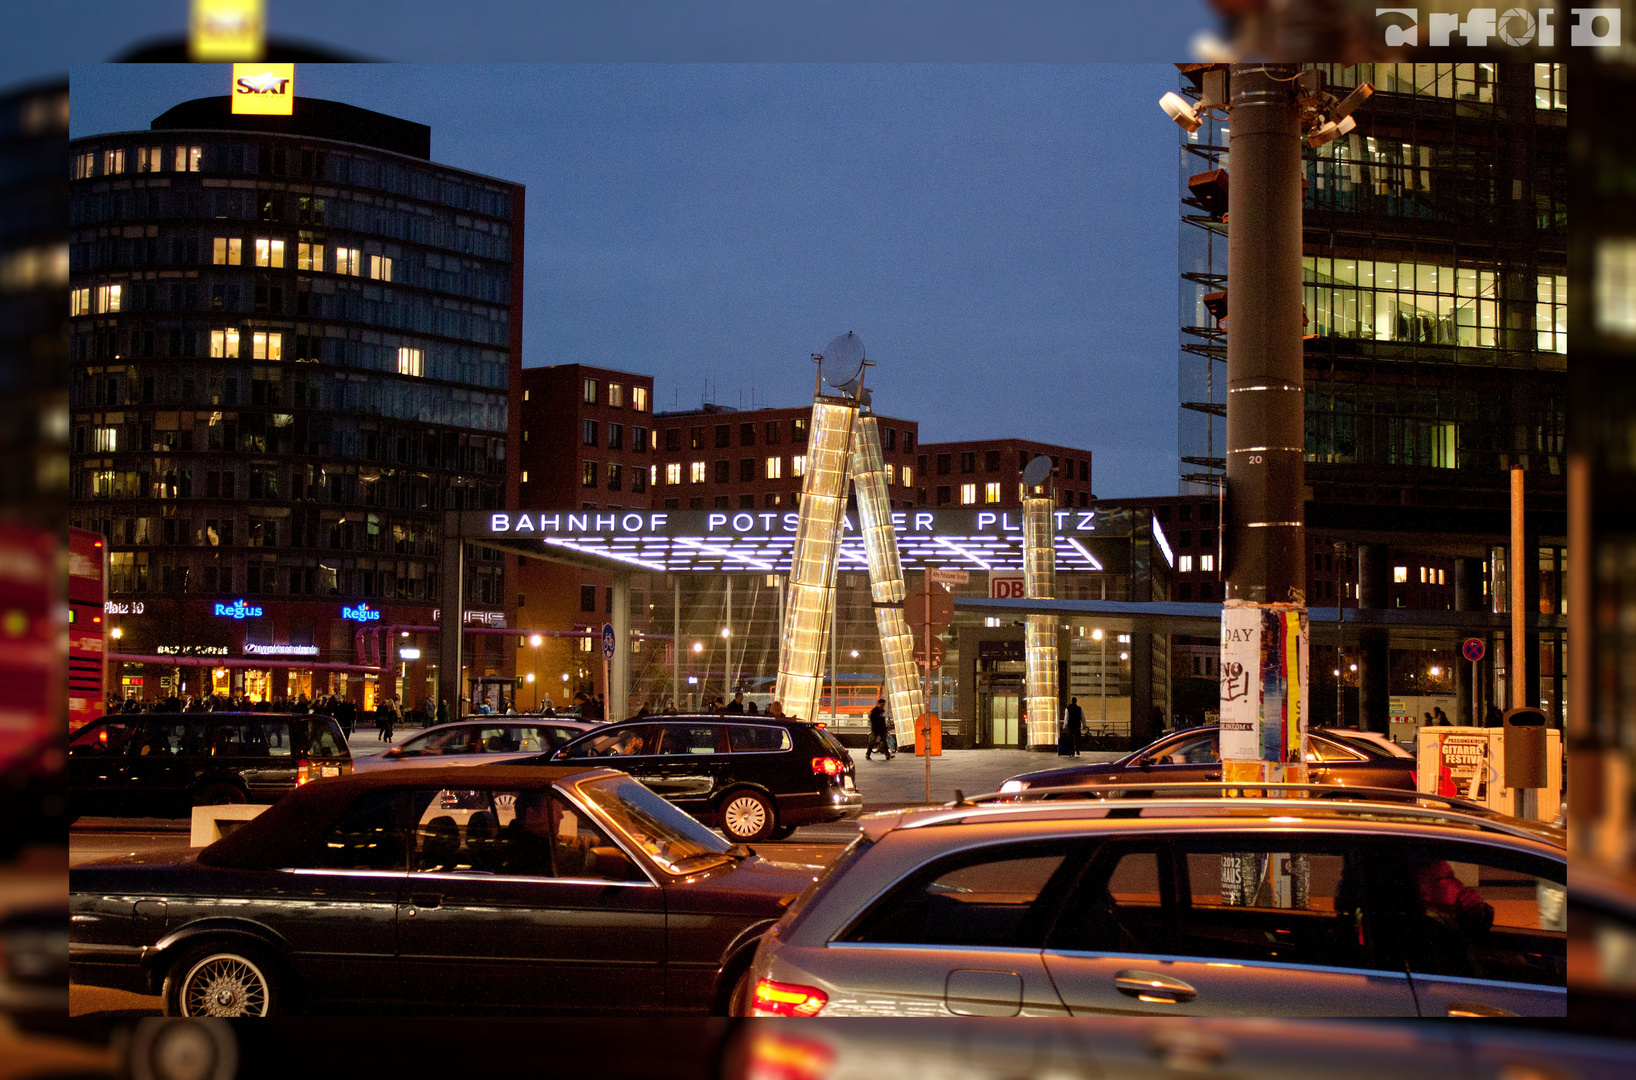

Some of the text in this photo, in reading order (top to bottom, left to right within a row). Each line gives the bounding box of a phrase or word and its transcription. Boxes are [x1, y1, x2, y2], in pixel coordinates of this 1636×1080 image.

[237, 76, 290, 95] SIXT
[1249, 455, 1262, 464] 20
[490, 511, 1095, 533] BAHNHOF POTSAER PLTZ
[997, 581, 1024, 598] DB
[214, 602, 263, 619] Regus
[342, 605, 380, 622] Regus
[1445, 754, 1481, 764] FESTIVA
